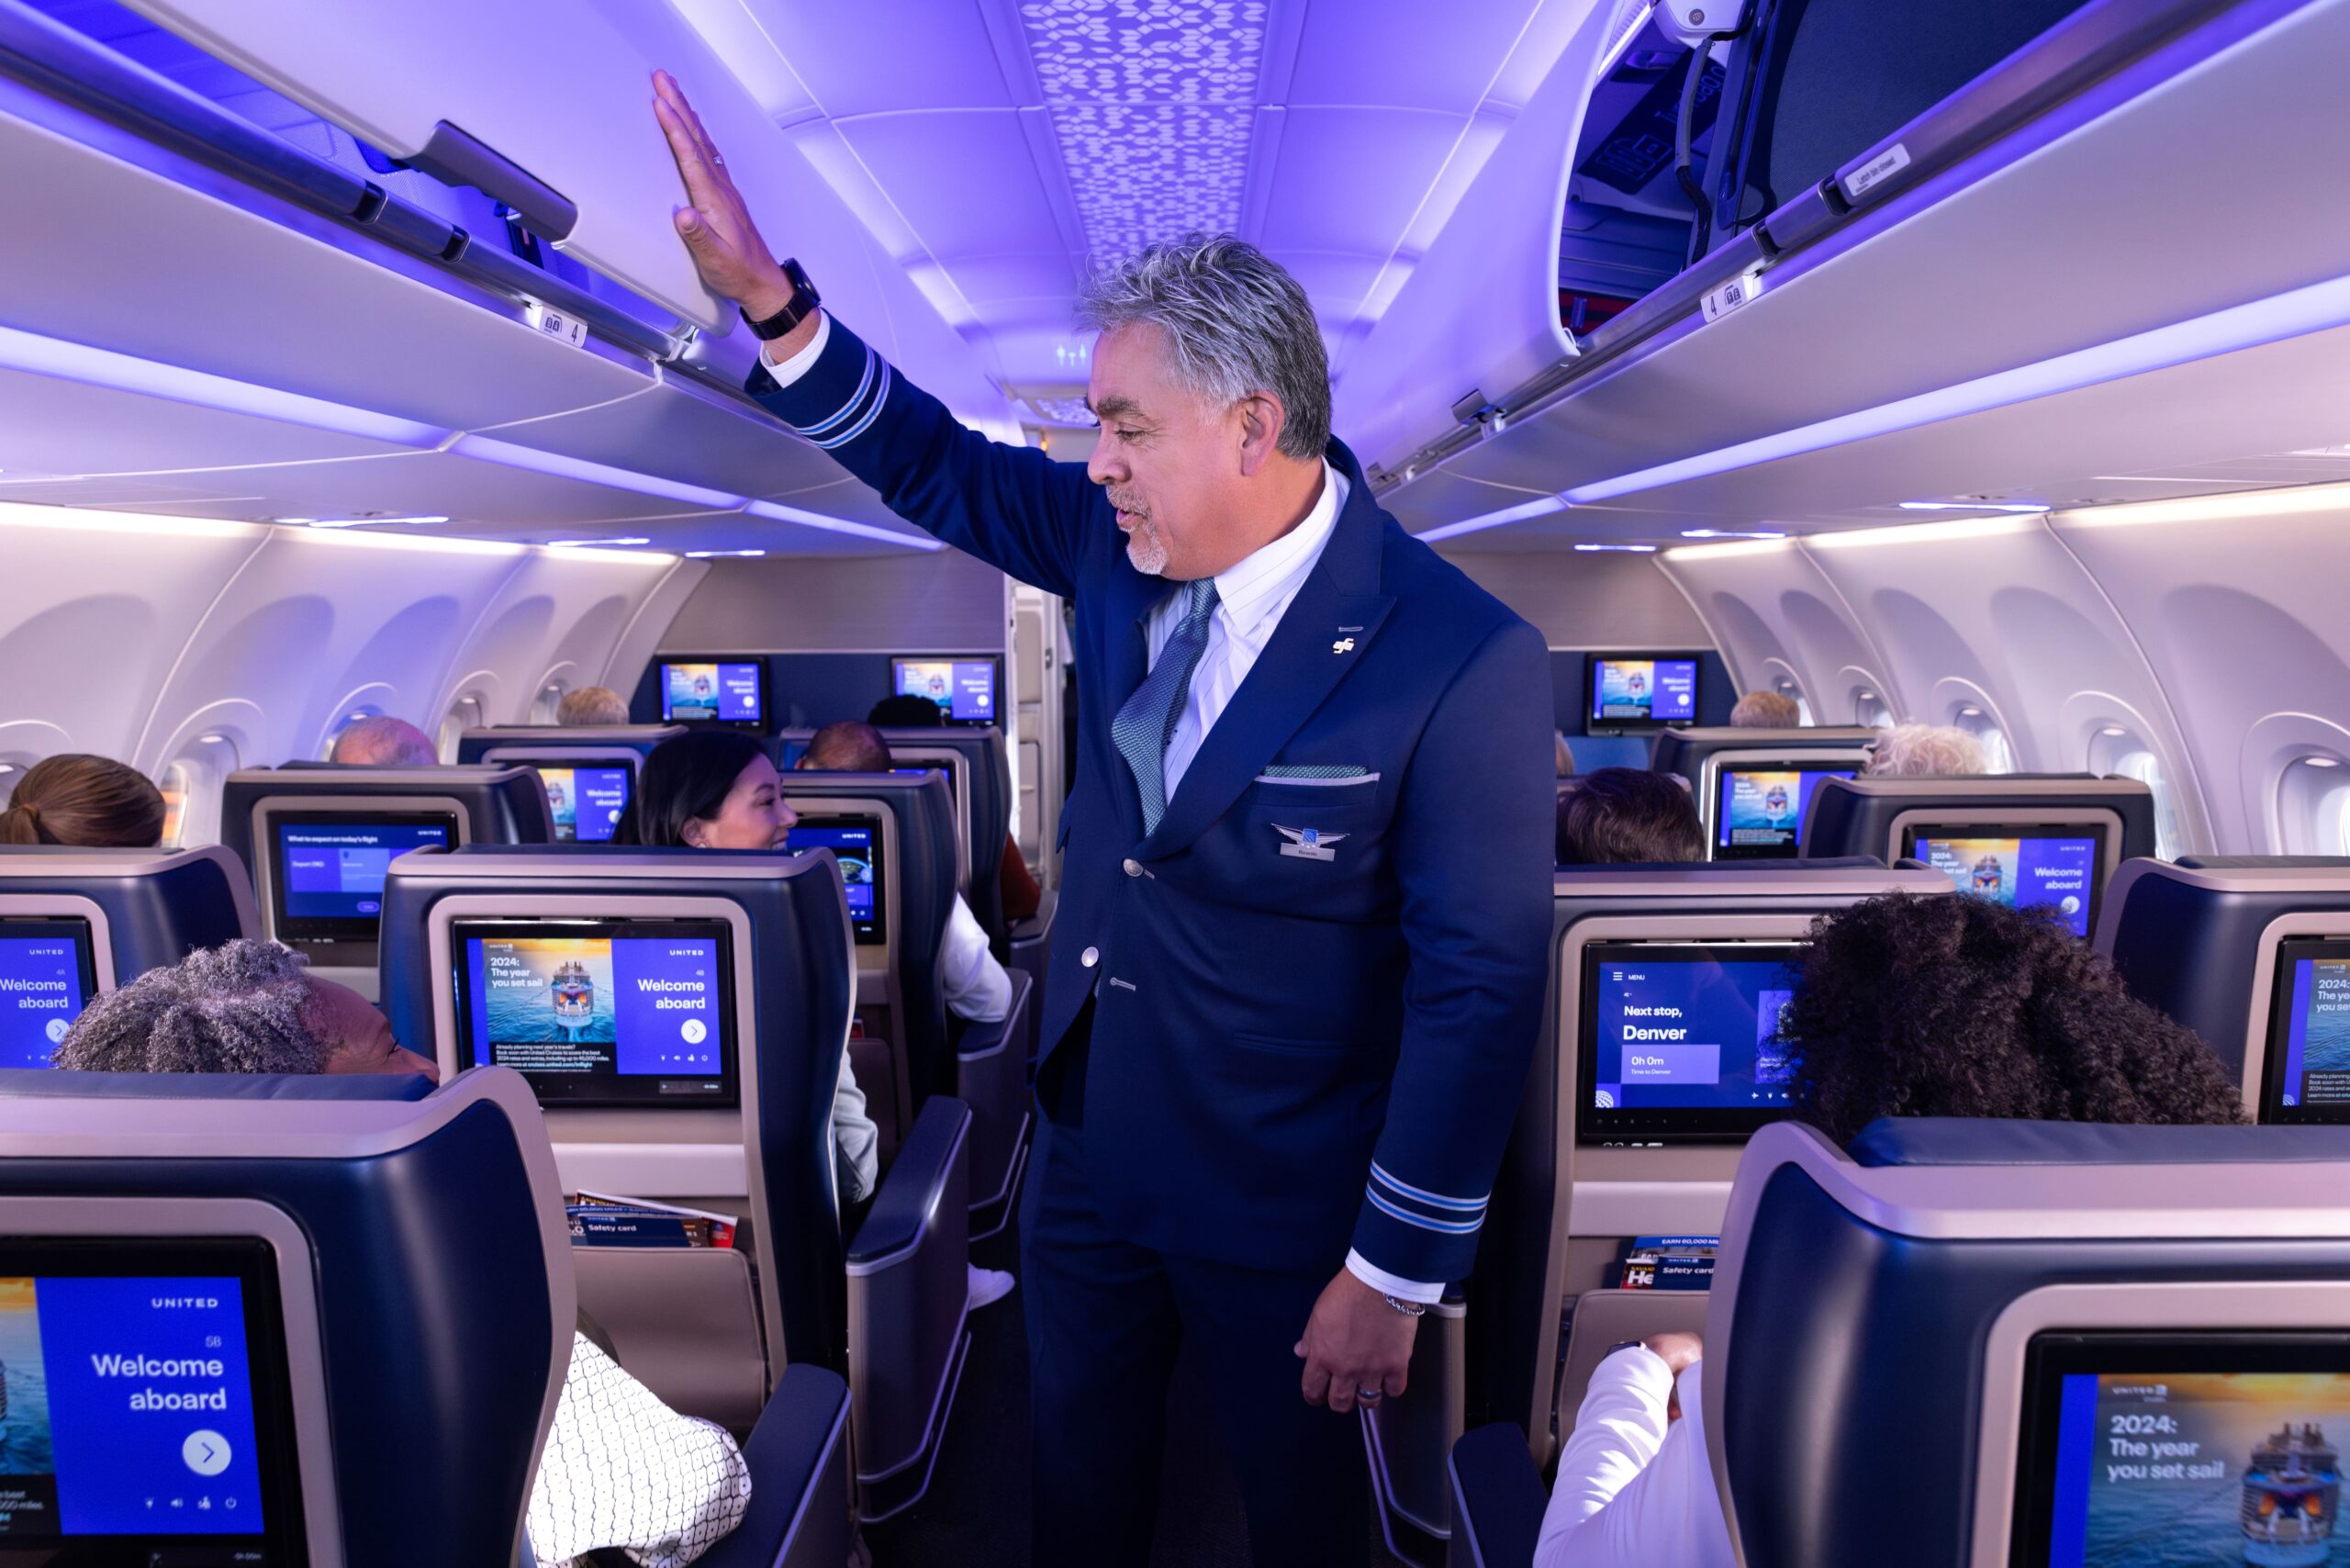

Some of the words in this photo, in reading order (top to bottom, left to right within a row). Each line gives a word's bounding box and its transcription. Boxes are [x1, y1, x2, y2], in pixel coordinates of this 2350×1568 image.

[1711, 295, 1717, 316] 4
[571, 324, 578, 342] 4
[2034, 867, 2083, 877] Welcome
[2045, 879, 2082, 889] aboard
[490, 957, 520, 967] 2024:
[491, 967, 508, 976] The
[509, 969, 531, 978] year
[0, 979, 67, 991] Welcome
[492, 979, 510, 989] you
[527, 978, 543, 987] sail
[638, 979, 705, 992] Welcome
[2318, 979, 2350, 989] 2024:
[2318, 991, 2336, 999] The
[18, 997, 68, 1008] aboard
[655, 997, 706, 1009] aboard
[2316, 1004, 2336, 1013] you
[1624, 1006, 1652, 1016] Next
[1653, 1007, 1683, 1018] stop,
[1623, 1025, 1687, 1040] Denver
[1631, 1056, 1645, 1065] 0h
[1647, 1056, 1664, 1065] 0m
[151, 1298, 218, 1308] UNITED
[92, 1354, 224, 1377] Welcome
[130, 1388, 227, 1411] aboard
[2110, 1415, 2178, 1434] 2024:
[2109, 1438, 2148, 1457] The
[2150, 1442, 2200, 1460] year
[2107, 1464, 2147, 1484] you
[2150, 1462, 2184, 1479] set
[2187, 1460, 2225, 1479] sail
